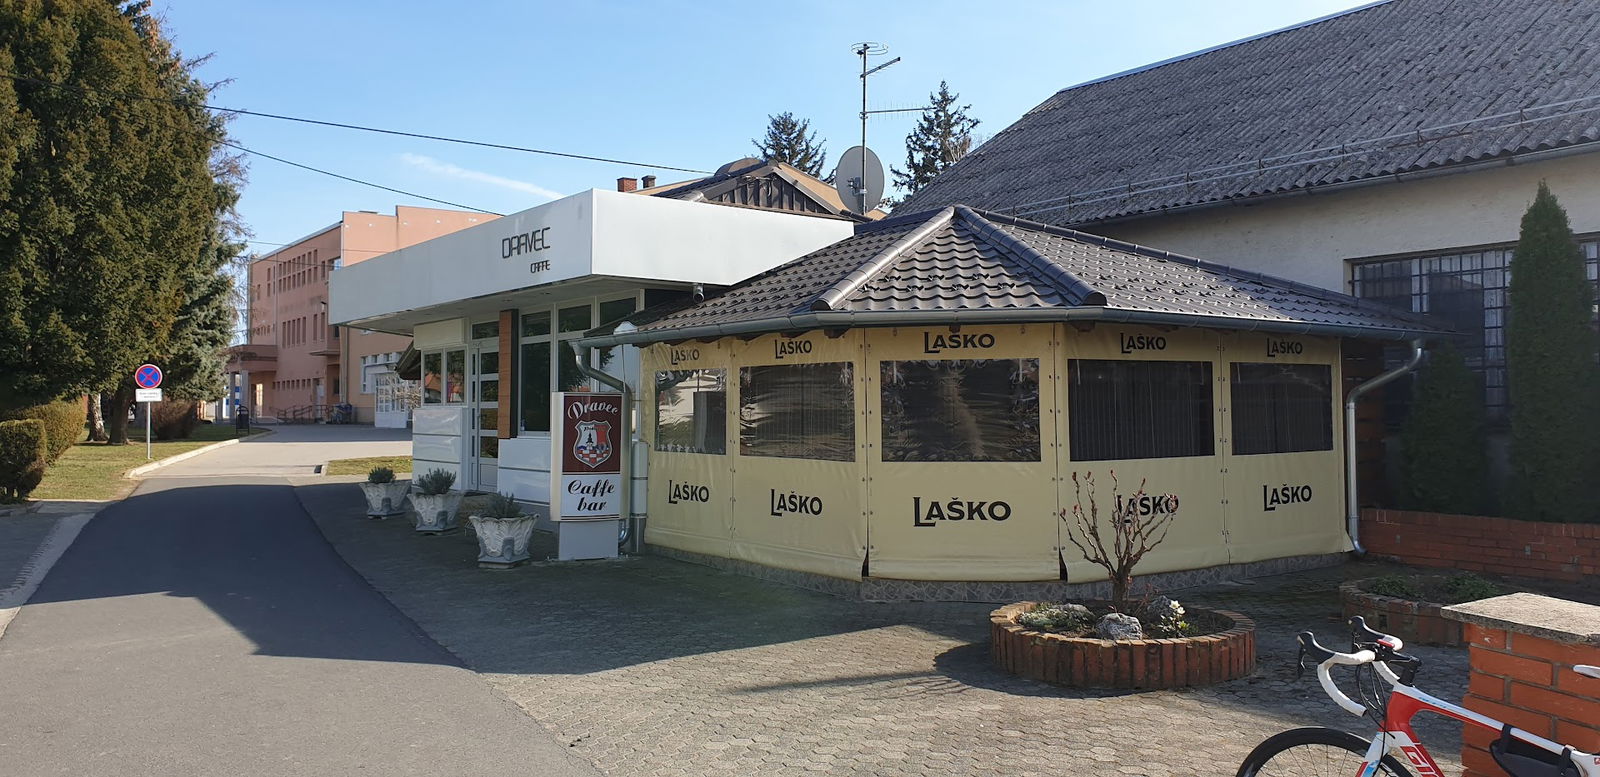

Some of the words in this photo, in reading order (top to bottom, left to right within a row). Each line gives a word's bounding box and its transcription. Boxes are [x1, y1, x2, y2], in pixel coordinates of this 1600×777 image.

[502, 226, 551, 259] DRAVEC
[774, 337, 813, 359] LAŠKO
[1119, 332, 1167, 354] LAŠKO
[670, 347, 700, 365] LAŠKO
[567, 401, 619, 420] Dravec
[567, 478, 616, 498] Caffe
[668, 479, 710, 504] LAŠKO
[1263, 483, 1313, 511] LAŠKO
[577, 496, 608, 512] bar
[770, 488, 823, 517] LAŠKO
[913, 496, 1012, 527] LAŠKO
